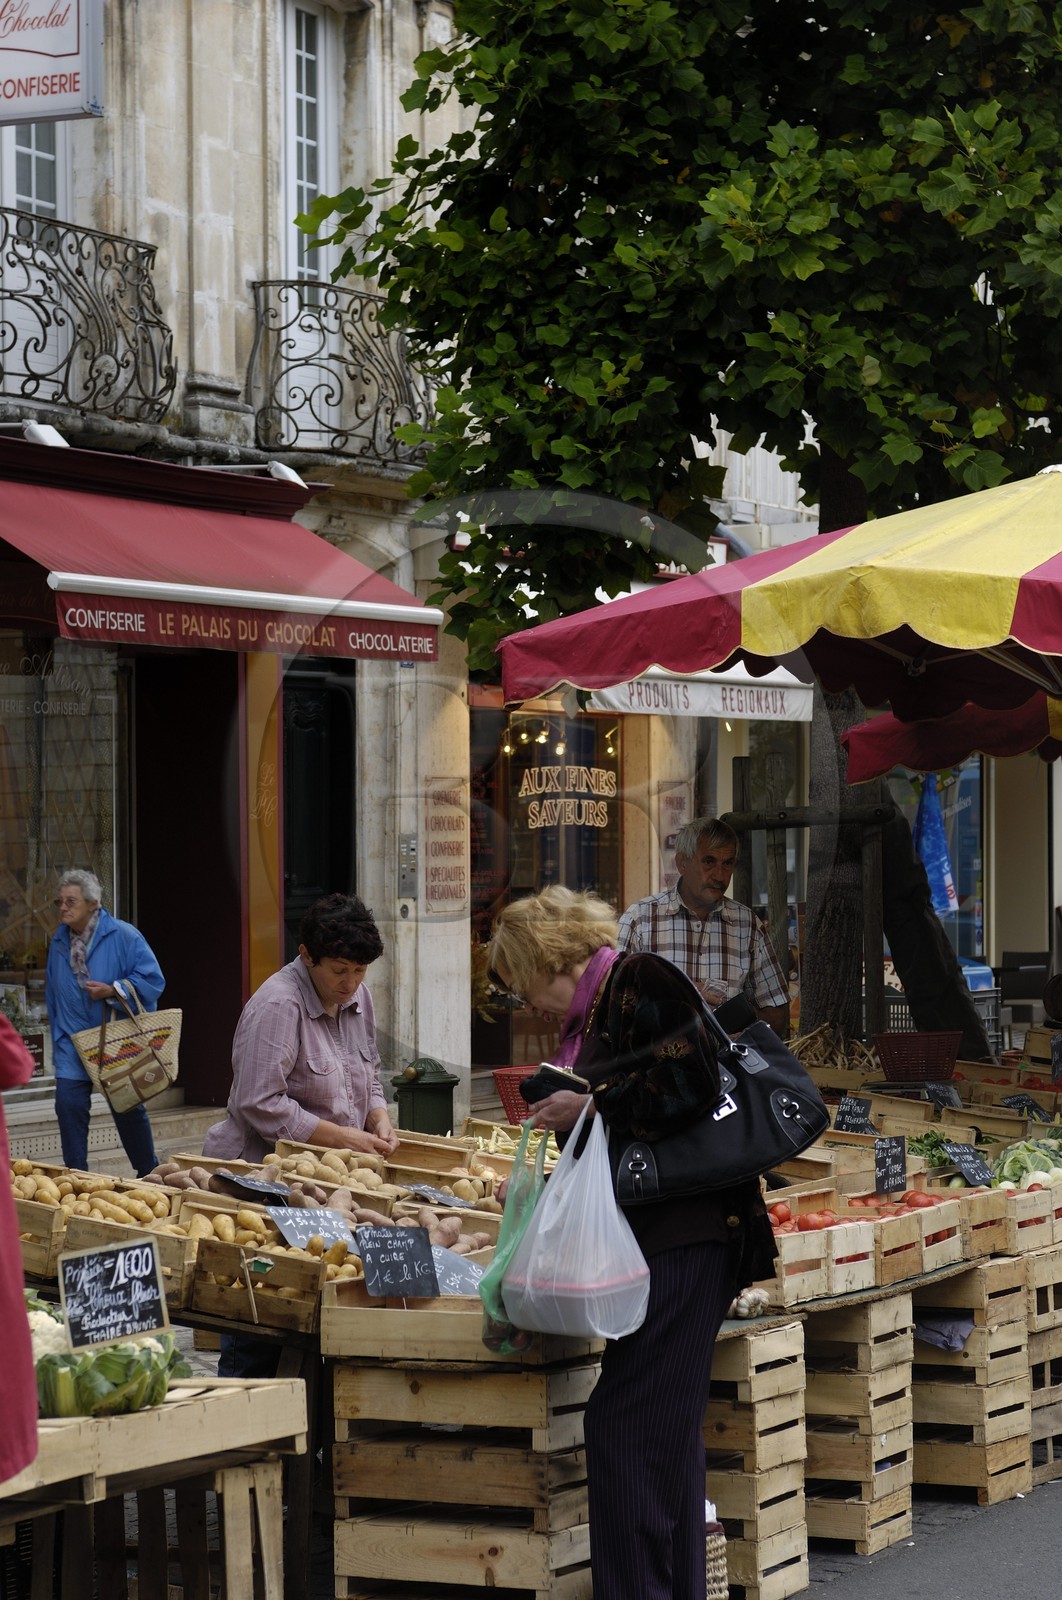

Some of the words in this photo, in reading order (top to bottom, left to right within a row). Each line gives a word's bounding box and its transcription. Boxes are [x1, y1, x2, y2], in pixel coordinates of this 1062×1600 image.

[0, 72, 80, 99] ONFISERIE
[65, 608, 146, 632] CONFISERIE
[159, 613, 174, 635] LE
[182, 614, 231, 639] PALAIS
[238, 620, 258, 641] DU
[265, 622, 336, 647] CHOCOLAT
[348, 632, 434, 654] CHOCOLATERIE
[628, 682, 690, 710] PRODUITS
[721, 687, 787, 715] REGIONAUX
[33, 701, 87, 716] CONFISERIE
[518, 767, 561, 797] AUX
[566, 765, 616, 797] FINES
[528, 799, 608, 829] SAVEURS
[430, 815, 465, 831] CHOCOLATS
[430, 841, 465, 857] CONFISERIE
[430, 884, 467, 900] REGIONALES
[269, 1207, 333, 1219] AMANDINE
[387, 1238, 414, 1251] CHAMP
[366, 1253, 373, 1264] A
[380, 1251, 405, 1263] CUIRE
[399, 1263, 413, 1283] le
